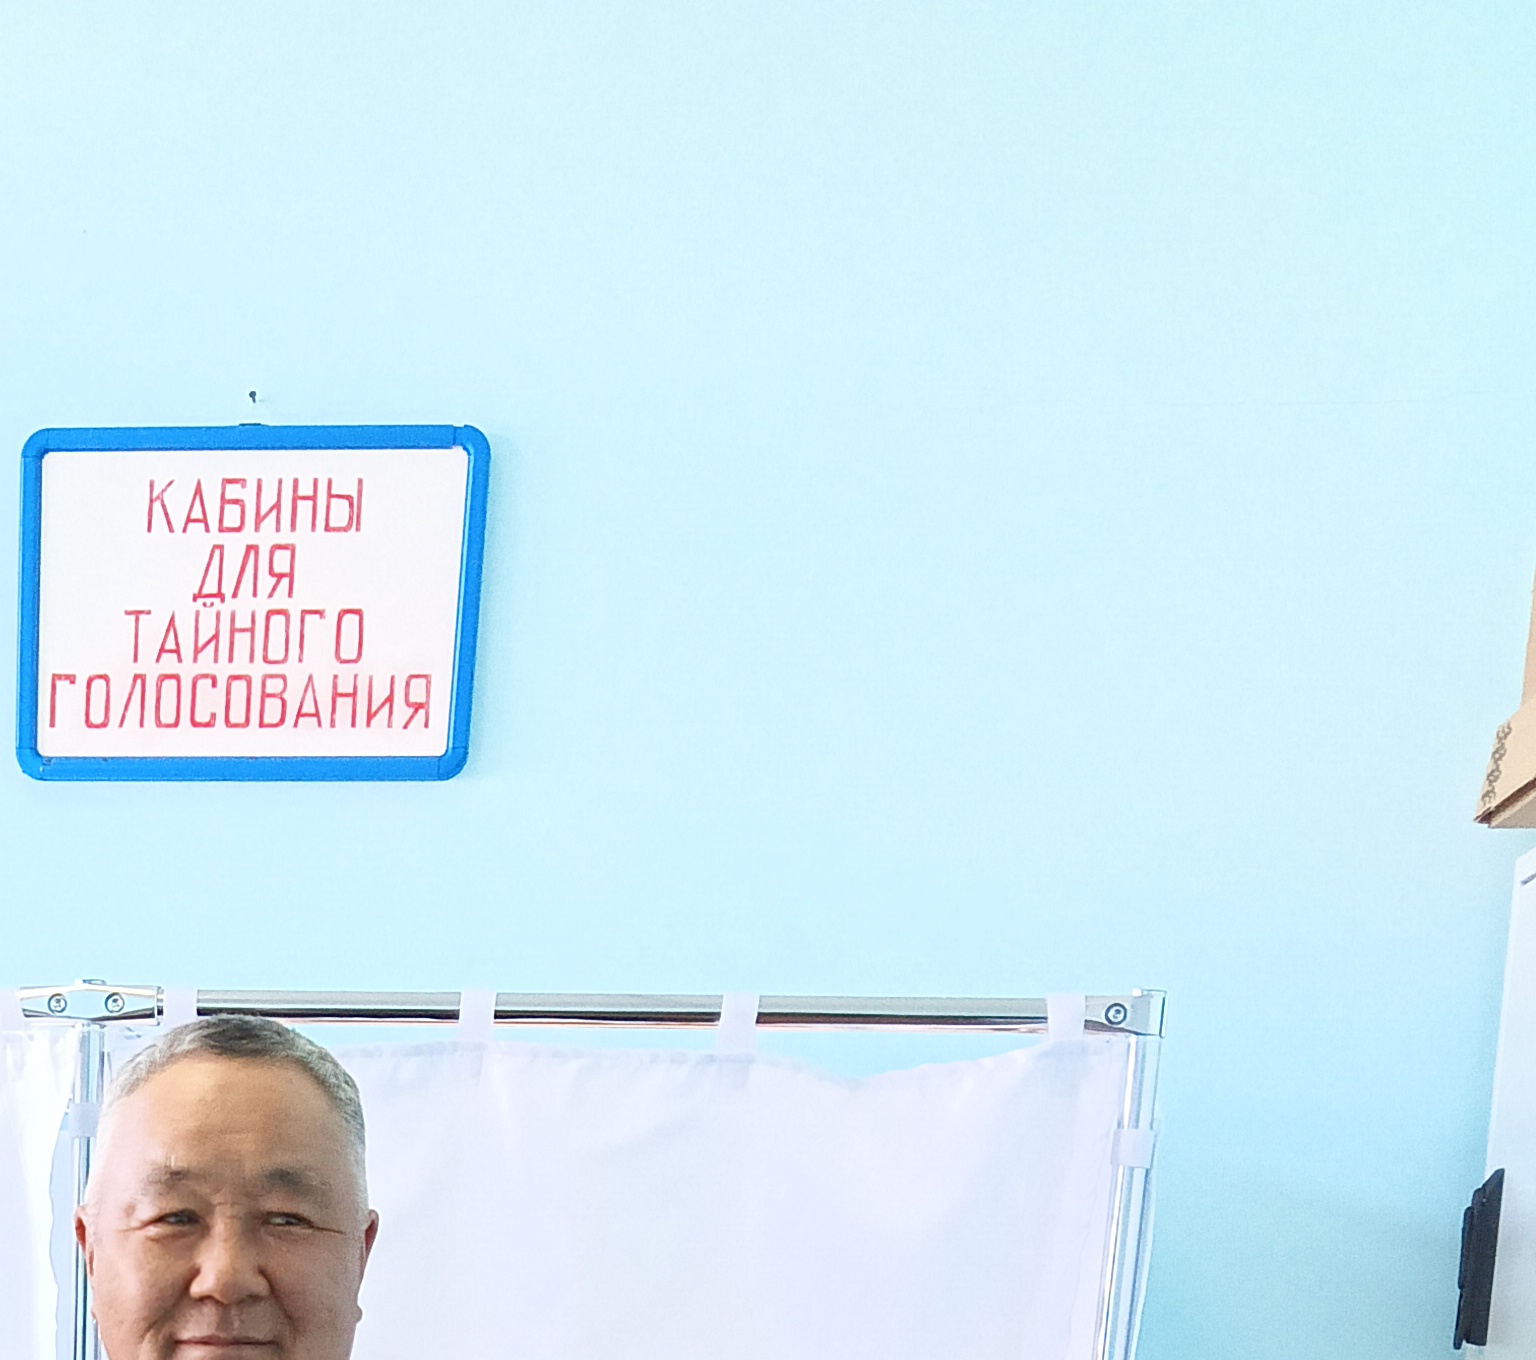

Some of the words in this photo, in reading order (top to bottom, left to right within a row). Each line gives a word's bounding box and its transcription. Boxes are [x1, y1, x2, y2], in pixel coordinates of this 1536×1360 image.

[146, 477, 363, 533] КАБИНЫ
[192, 543, 296, 602] ДЛЯ
[124, 601, 364, 664] ТАЙНОГО
[48, 673, 432, 730] ГОЛОСОВАНИЯ
